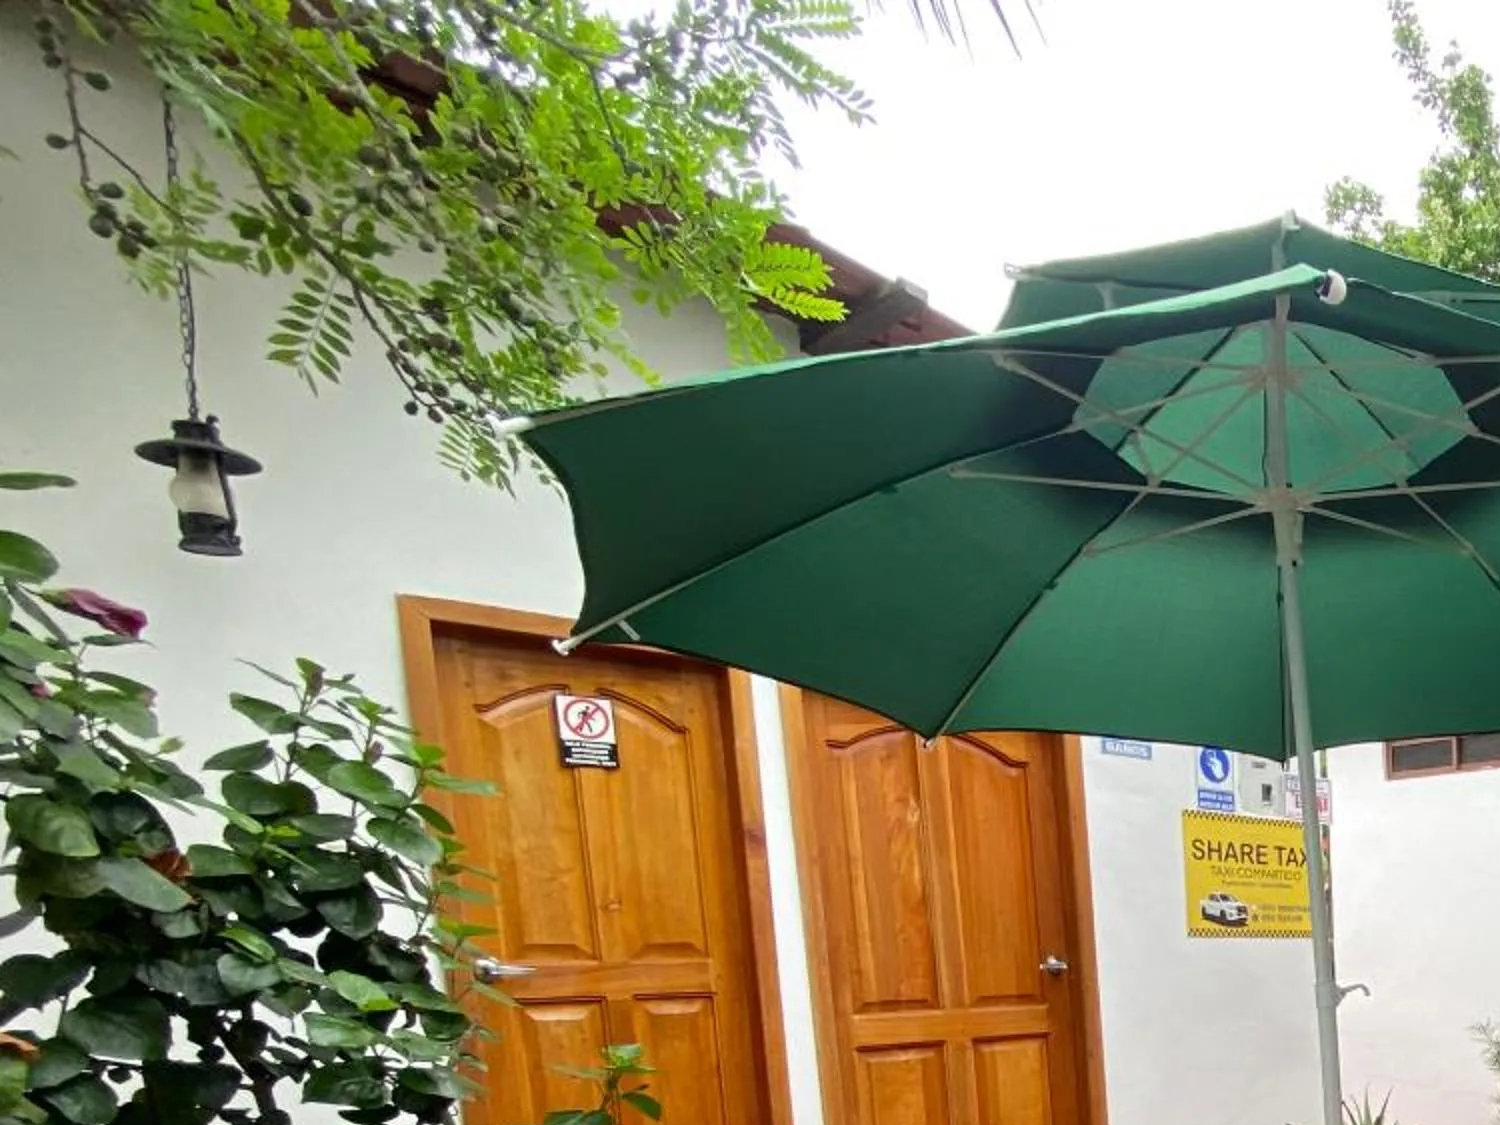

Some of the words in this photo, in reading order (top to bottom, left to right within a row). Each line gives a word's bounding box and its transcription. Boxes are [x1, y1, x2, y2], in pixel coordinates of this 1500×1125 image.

[1191, 838, 1268, 866] SHARE
[1274, 845, 1308, 868] TAX
[1210, 864, 1234, 877] TAXI
